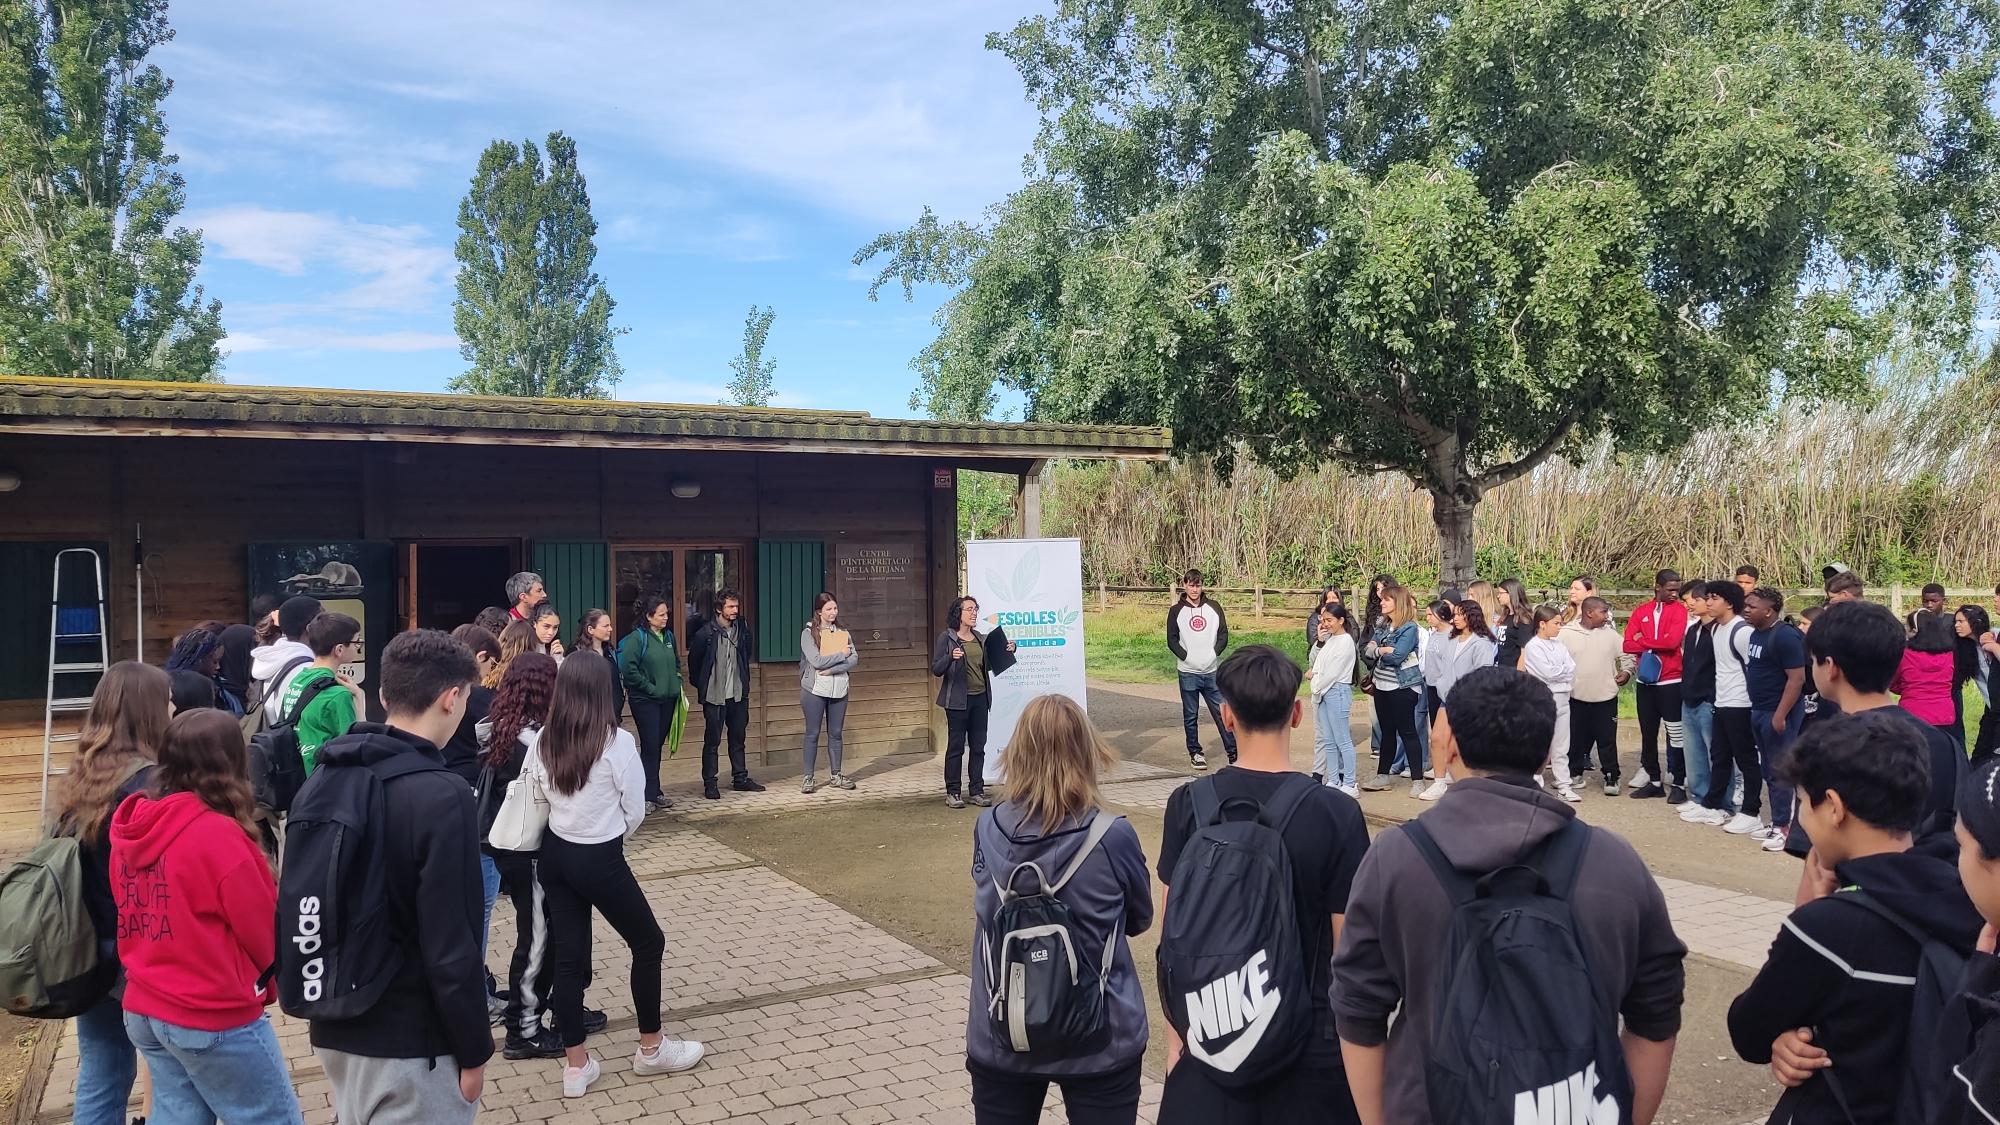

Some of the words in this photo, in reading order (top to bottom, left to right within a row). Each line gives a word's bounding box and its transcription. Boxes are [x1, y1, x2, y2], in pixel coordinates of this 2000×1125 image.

[998, 611, 1057, 626] ESCOLES
[1031, 949, 1048, 960] KCB
[1185, 949, 1271, 1043] NIKE
